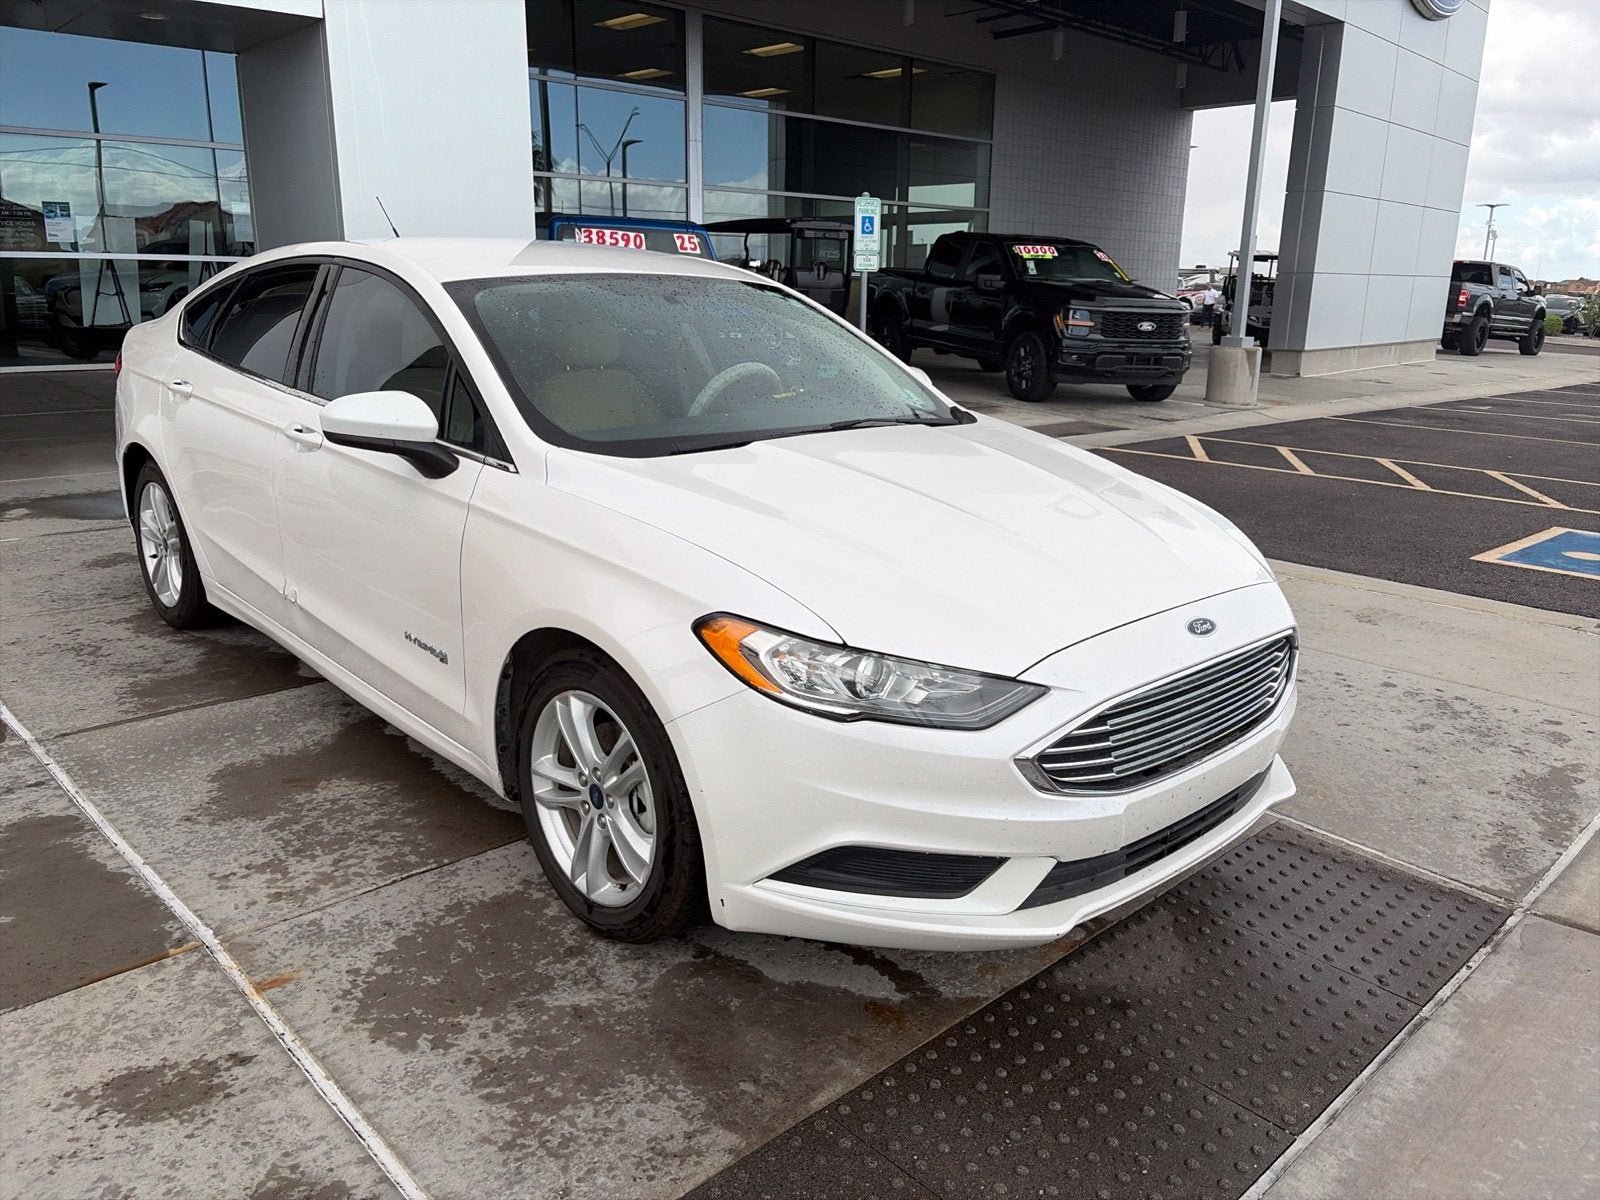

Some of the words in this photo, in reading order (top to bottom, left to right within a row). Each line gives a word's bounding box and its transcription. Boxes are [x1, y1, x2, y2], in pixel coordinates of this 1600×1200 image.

[858, 207, 877, 215] PARKING
[676, 235, 698, 252] 25
[1193, 620, 1213, 634] Ford
